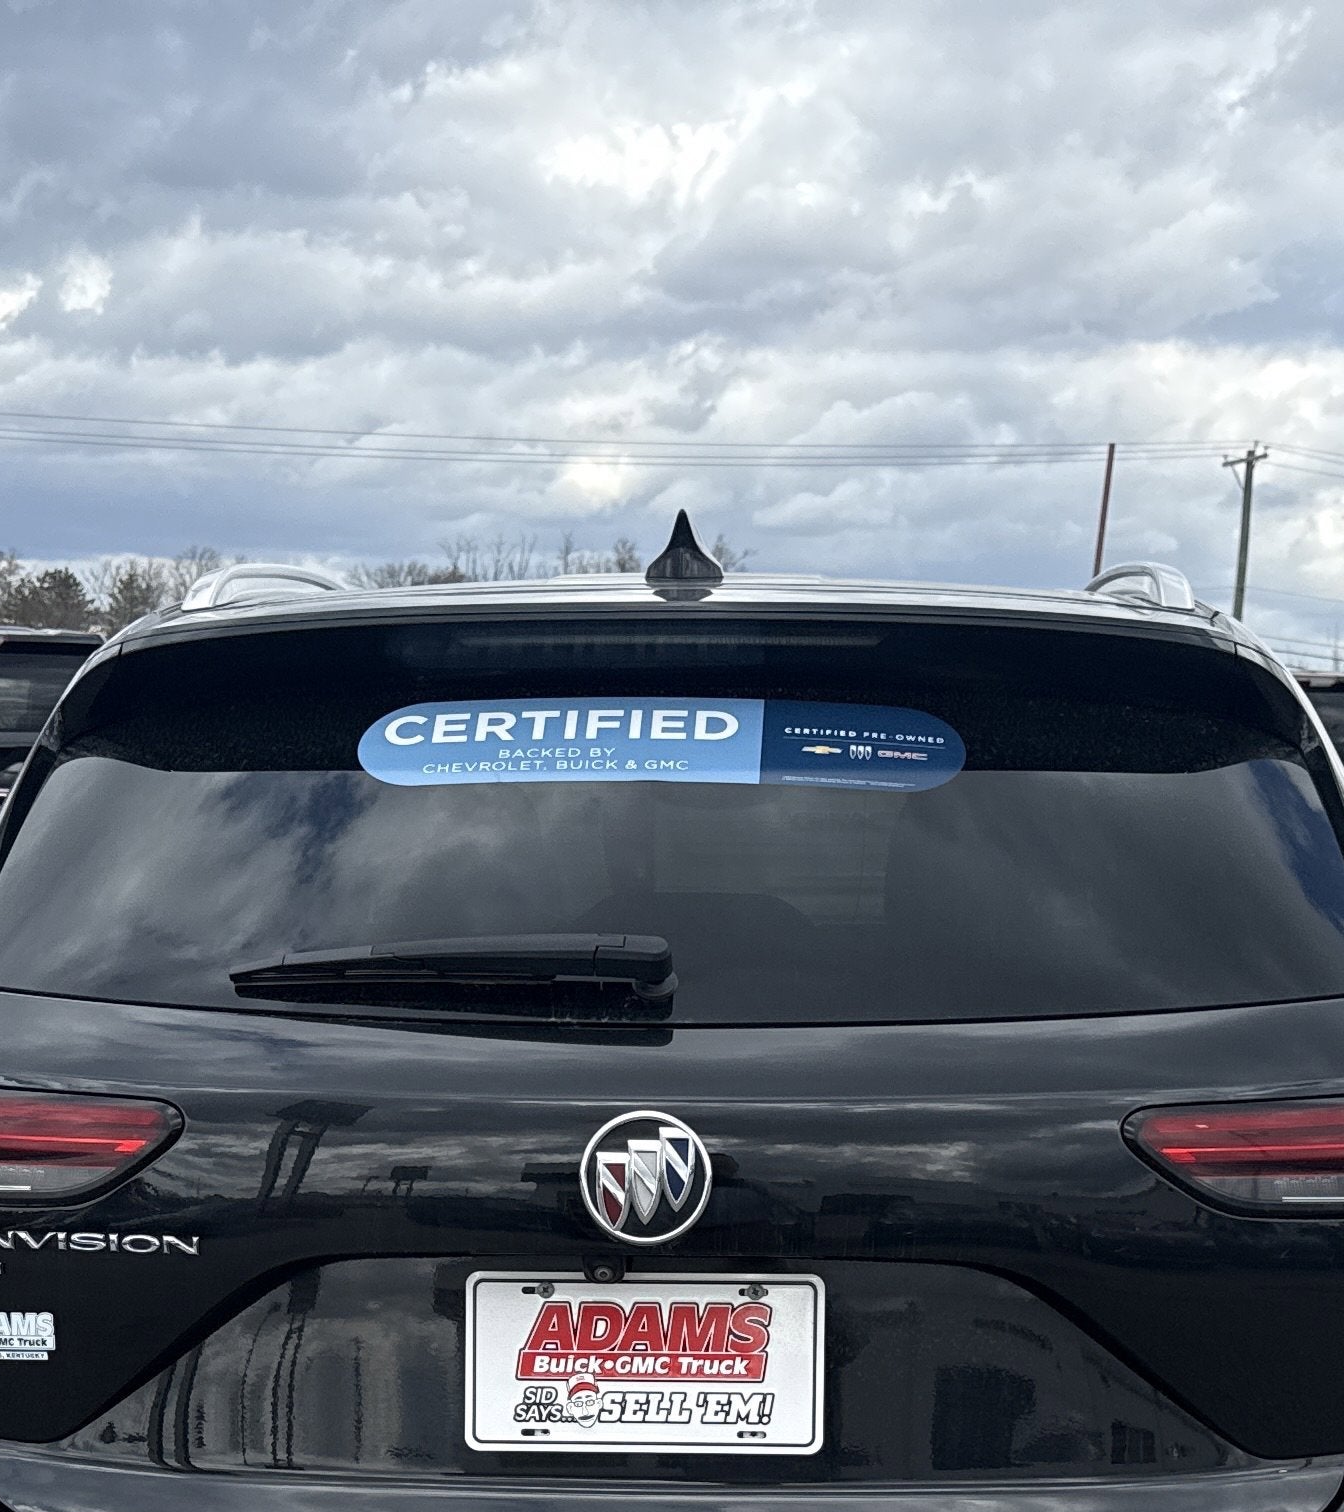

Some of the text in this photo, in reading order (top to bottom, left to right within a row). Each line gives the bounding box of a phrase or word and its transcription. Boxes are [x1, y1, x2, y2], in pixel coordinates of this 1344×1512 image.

[384, 709, 739, 746] CERTIFIED
[784, 727, 945, 744] CERTIFIED PRE-OWNED
[498, 747, 616, 759] BACKED BY
[877, 750, 928, 761] GMC
[423, 759, 690, 774] CHEVROLET, BUICK & GMC
[522, 1300, 774, 1354] ADAMS
[16, 1337, 48, 1347] Truck
[678, 1356, 750, 1376] Truck
[523, 1386, 559, 1405] SID
[598, 1391, 775, 1426] SELL 'EM!
